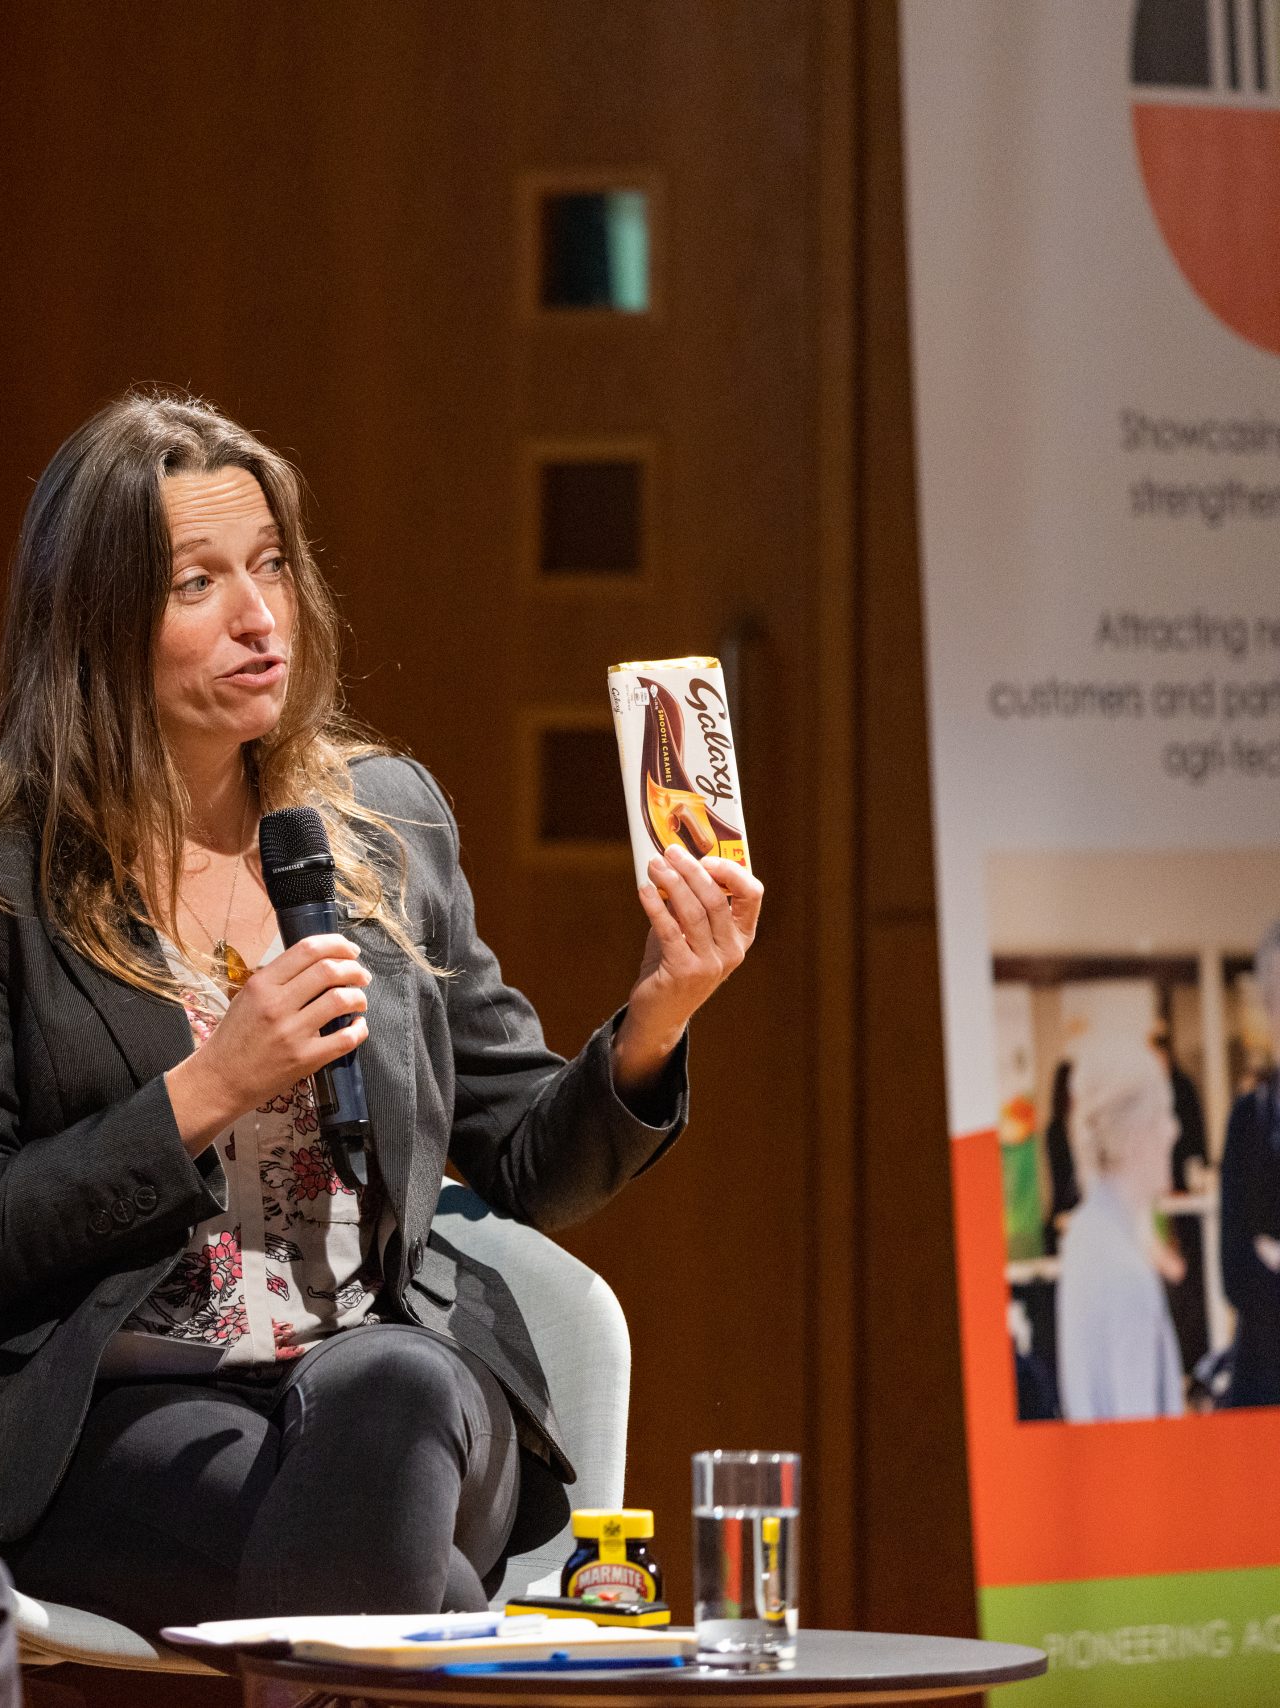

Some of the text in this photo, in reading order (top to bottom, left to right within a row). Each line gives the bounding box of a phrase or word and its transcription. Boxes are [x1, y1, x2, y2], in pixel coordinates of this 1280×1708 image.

[1130, 476, 1280, 528] strengthe
[1097, 611, 1249, 661] Attracting
[1151, 674, 1216, 719] and
[658, 709, 672, 783] SMOOTH CARAMEL
[684, 678, 733, 806] Galaxy
[272, 863, 304, 874] SENNHEISER
[578, 1564, 644, 1588] MARMITE
[1041, 1618, 1234, 1670] PIONEERING
